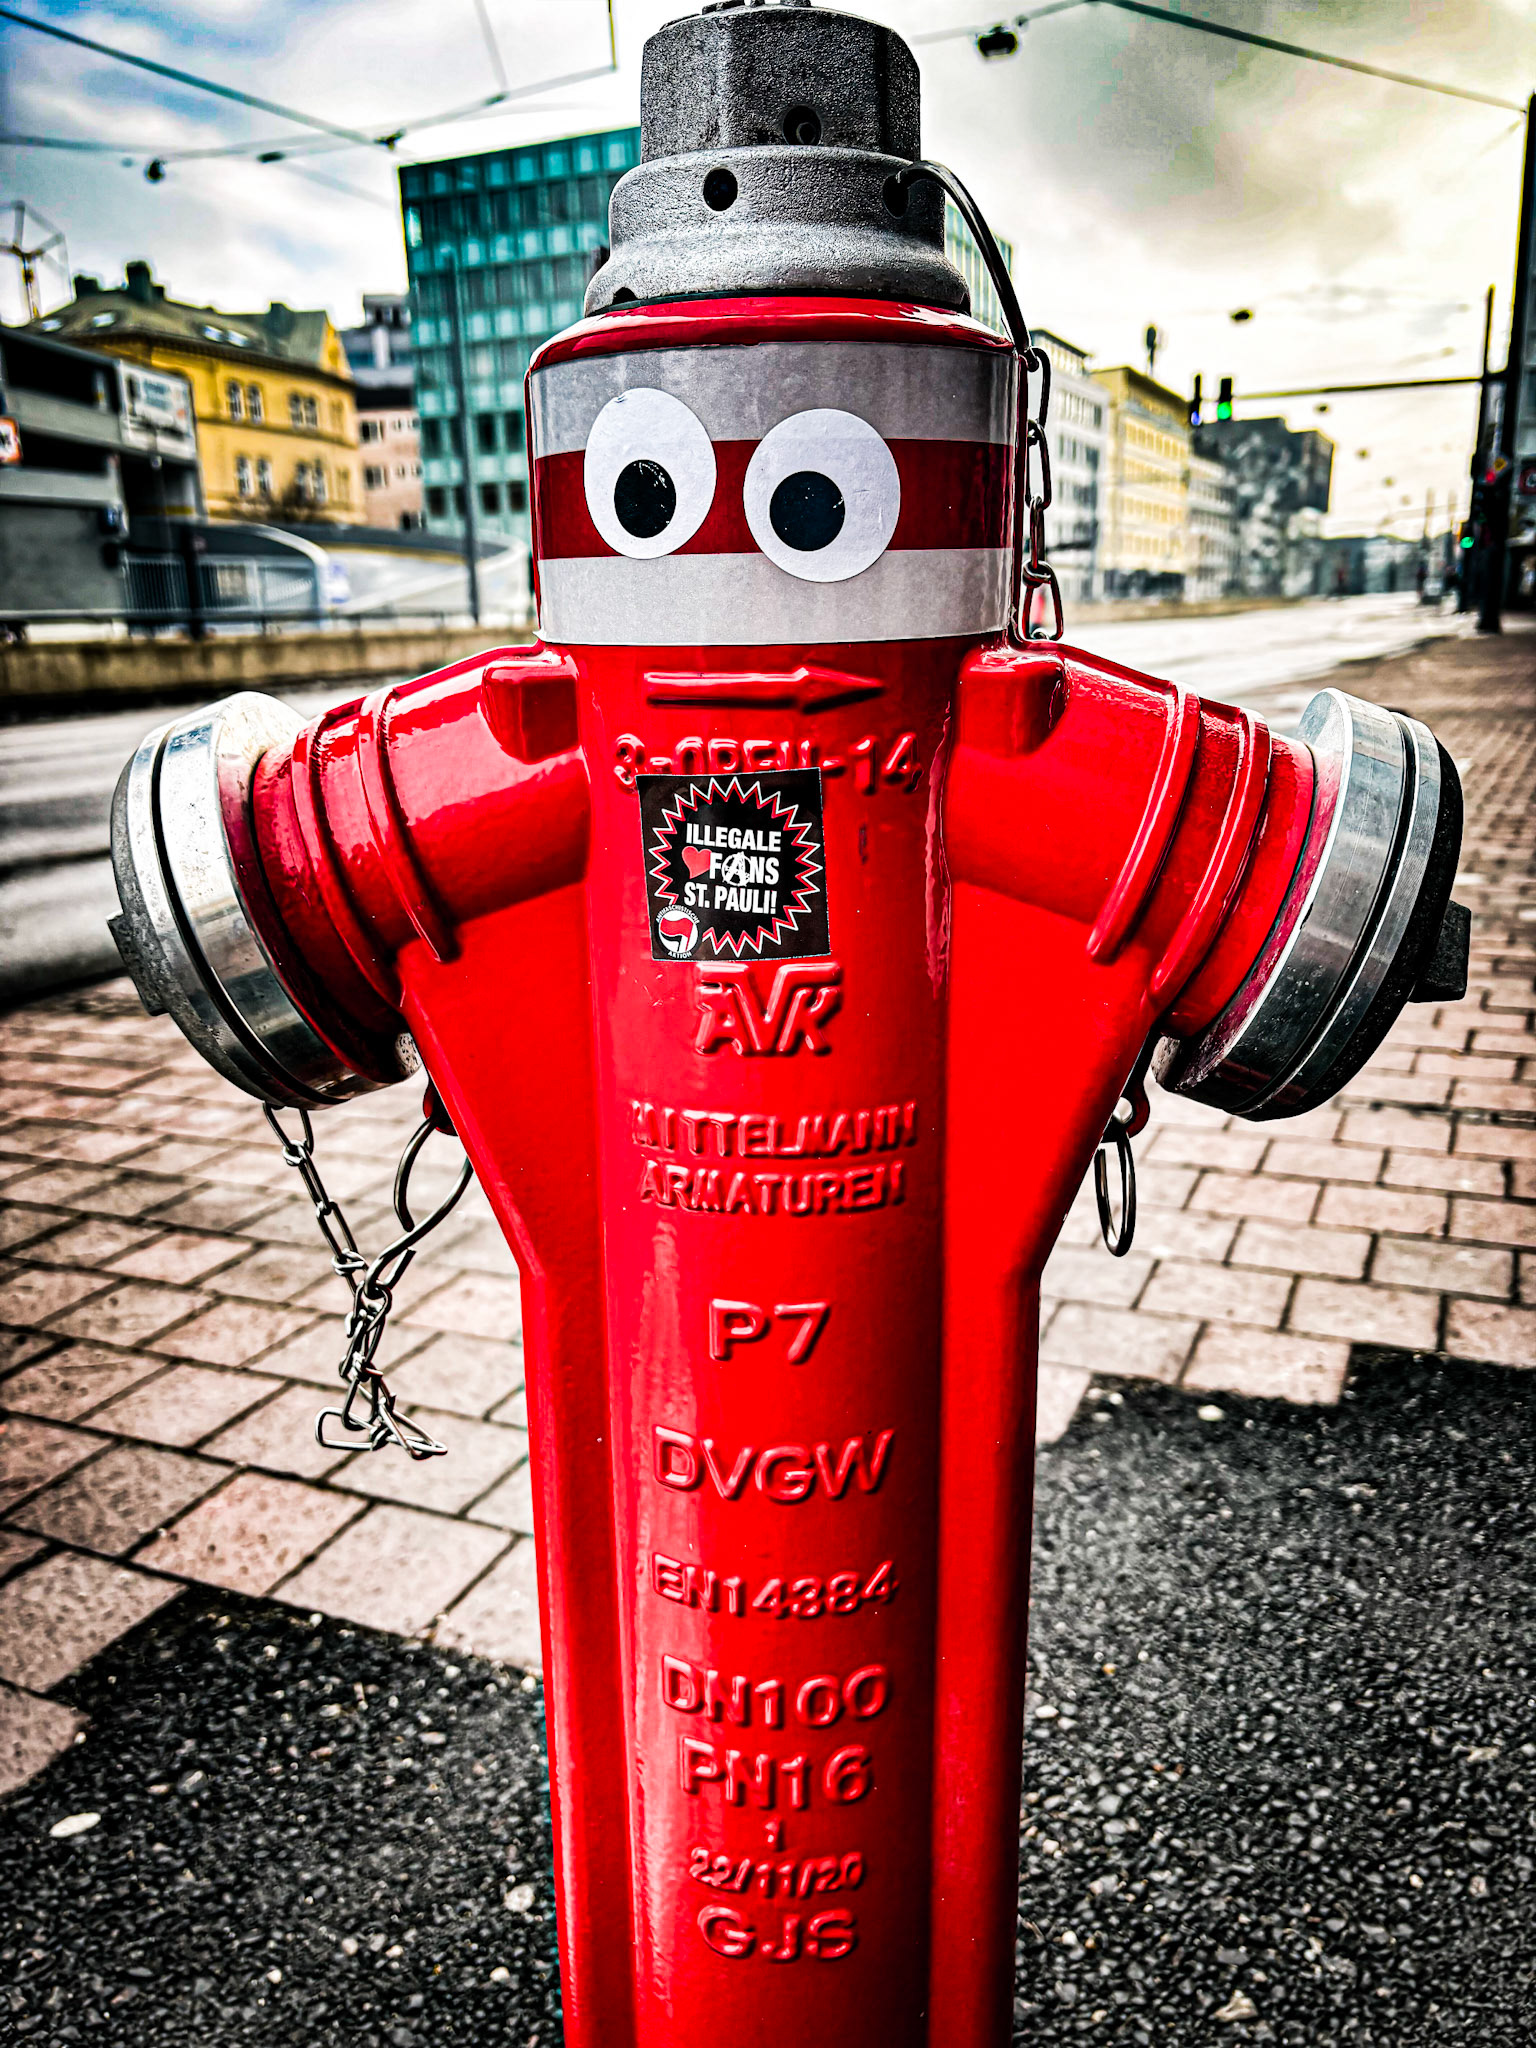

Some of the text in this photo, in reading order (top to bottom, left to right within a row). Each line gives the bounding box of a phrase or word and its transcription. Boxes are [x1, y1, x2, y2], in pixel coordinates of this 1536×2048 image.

[686, 823, 781, 852] ILLEGALE
[684, 881, 777, 914] ST. PAULI!
[709, 851, 780, 887] FANS
[668, 950, 692, 959] AKTION
[629, 1099, 917, 1158] MITTELMANN
[639, 1159, 904, 1217] ARMATUREN
[709, 1298, 831, 1364] P7
[653, 1425, 895, 1504] DVGW
[653, 1552, 898, 1619] EN14384
[662, 1654, 889, 1729] DN100
[679, 1736, 873, 1808] PN16
[688, 1846, 868, 1898] 22/11/20
[697, 1903, 857, 1963] GJS
